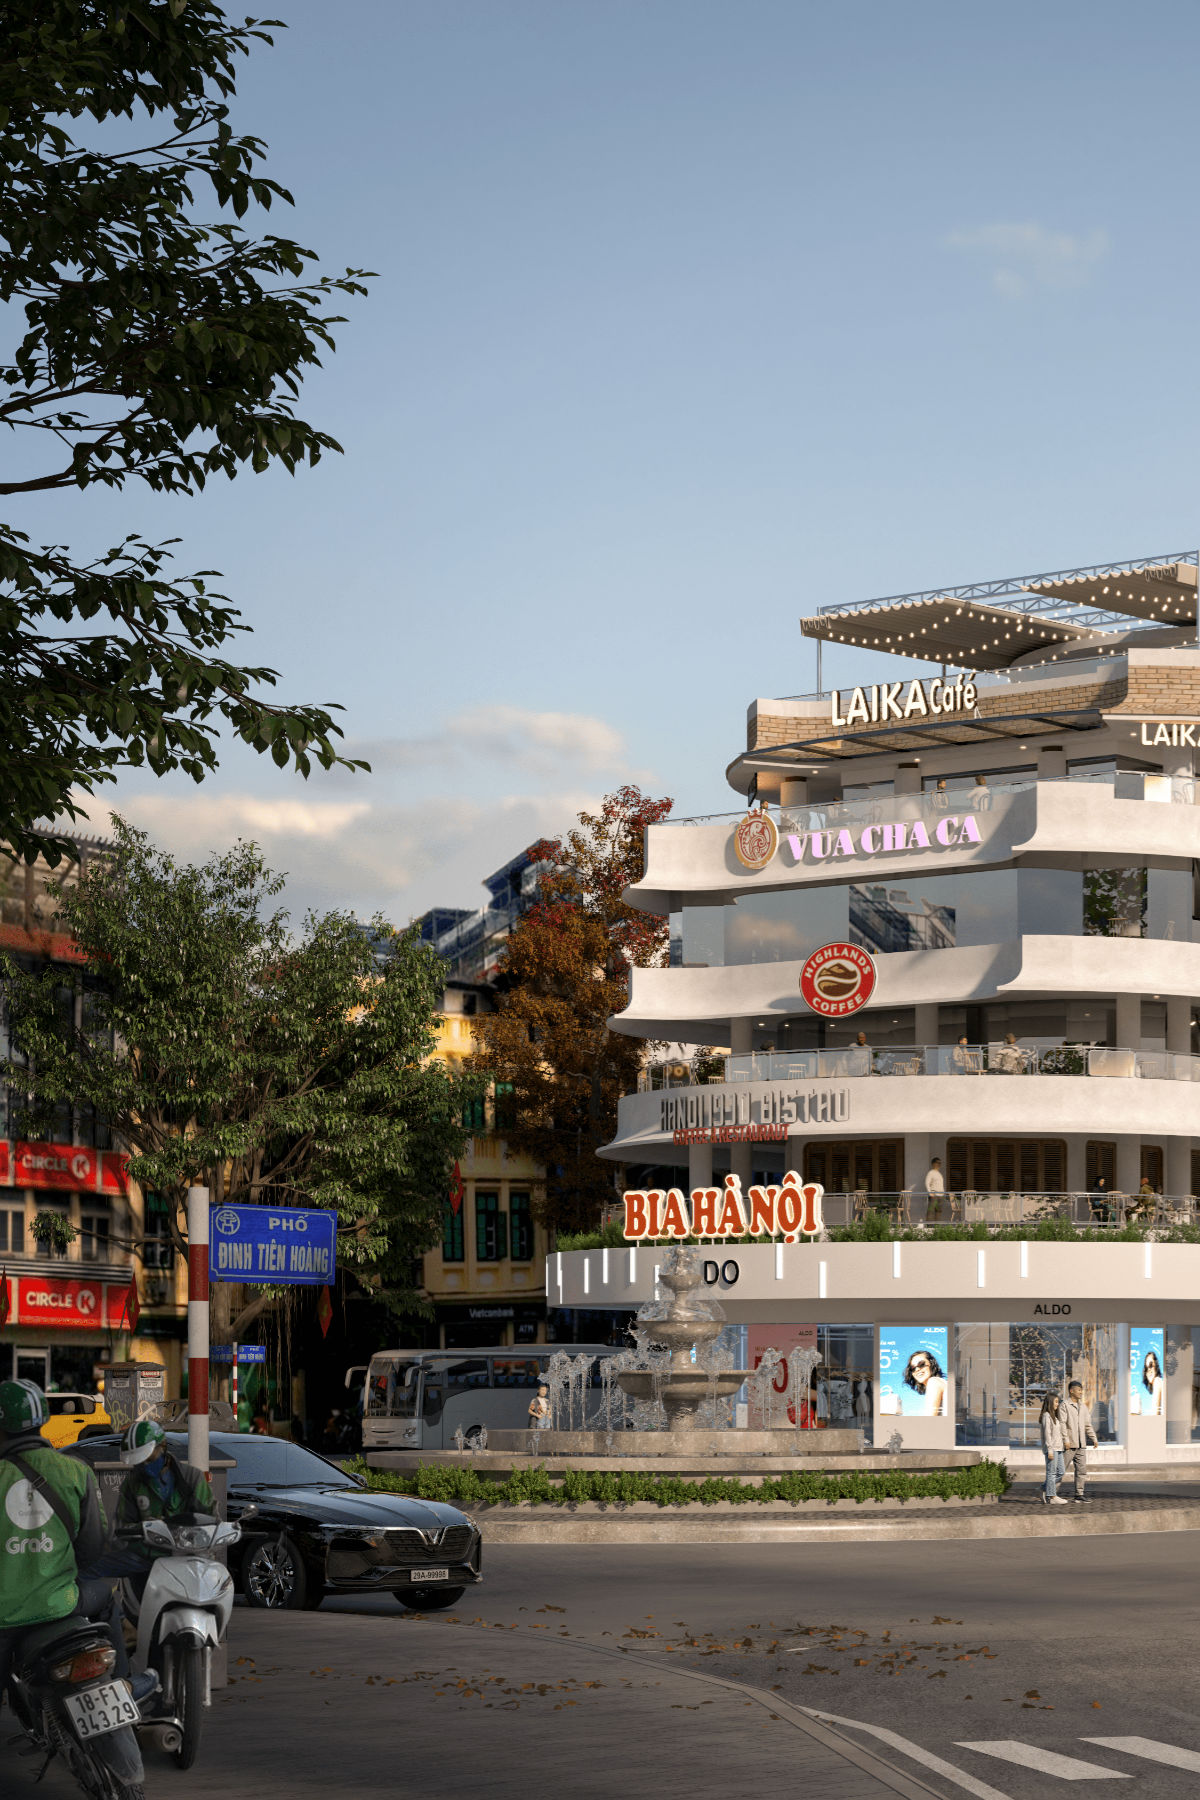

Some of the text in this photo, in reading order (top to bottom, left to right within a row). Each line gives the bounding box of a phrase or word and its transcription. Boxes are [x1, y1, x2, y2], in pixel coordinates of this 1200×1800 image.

[831, 673, 977, 726] LAIKA Café
[787, 815, 984, 860] VUA CHA CA
[804, 947, 872, 979] HIGHLANDS
[812, 993, 864, 1013] COFFEE
[673, 1127, 710, 1146] COFFEE
[22, 1154, 90, 1179] CIRCLE K
[623, 1170, 825, 1244] BIA HÀ NỘI
[268, 1215, 309, 1232] PHỐ
[218, 1239, 328, 1273] ĐINH TIÊN HOÀNG
[26, 1289, 95, 1314] CIRCLE K
[1034, 1304, 1071, 1315] ALDO
[5, 1531, 54, 1555] Grab
[75, 1685, 120, 1713] 18-F1
[76, 1701, 136, 1736] 343.29
